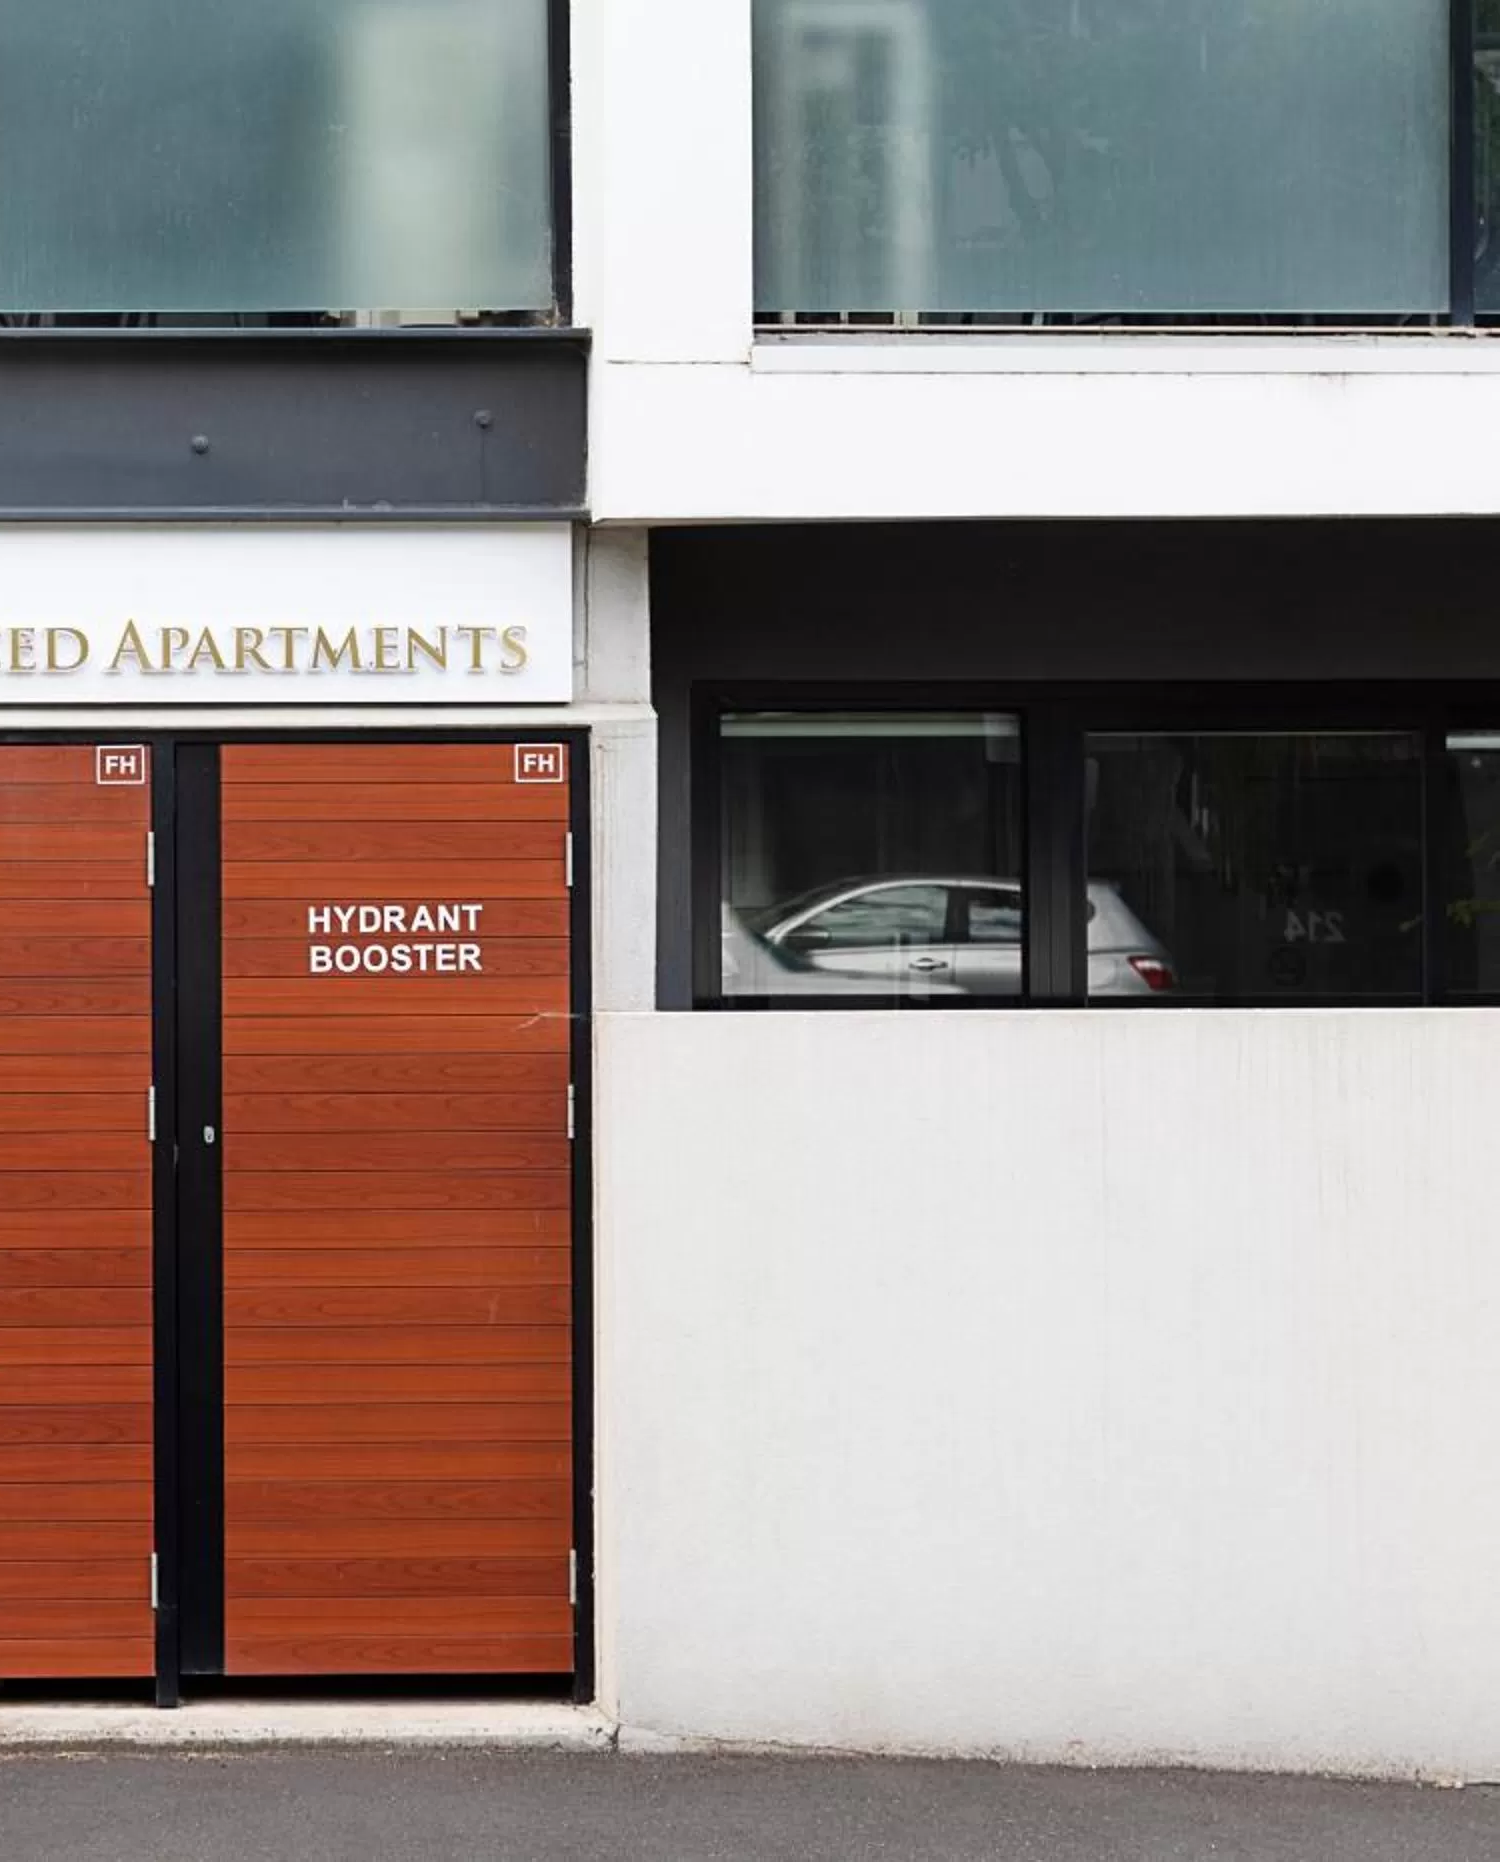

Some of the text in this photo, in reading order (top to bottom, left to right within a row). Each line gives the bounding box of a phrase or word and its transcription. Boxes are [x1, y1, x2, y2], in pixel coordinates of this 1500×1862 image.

[108, 618, 530, 674] APARTMENTS
[105, 754, 137, 776] FH
[523, 753, 555, 773] FH
[307, 903, 485, 934] HYDRANT
[308, 943, 484, 974] BOOSTER
